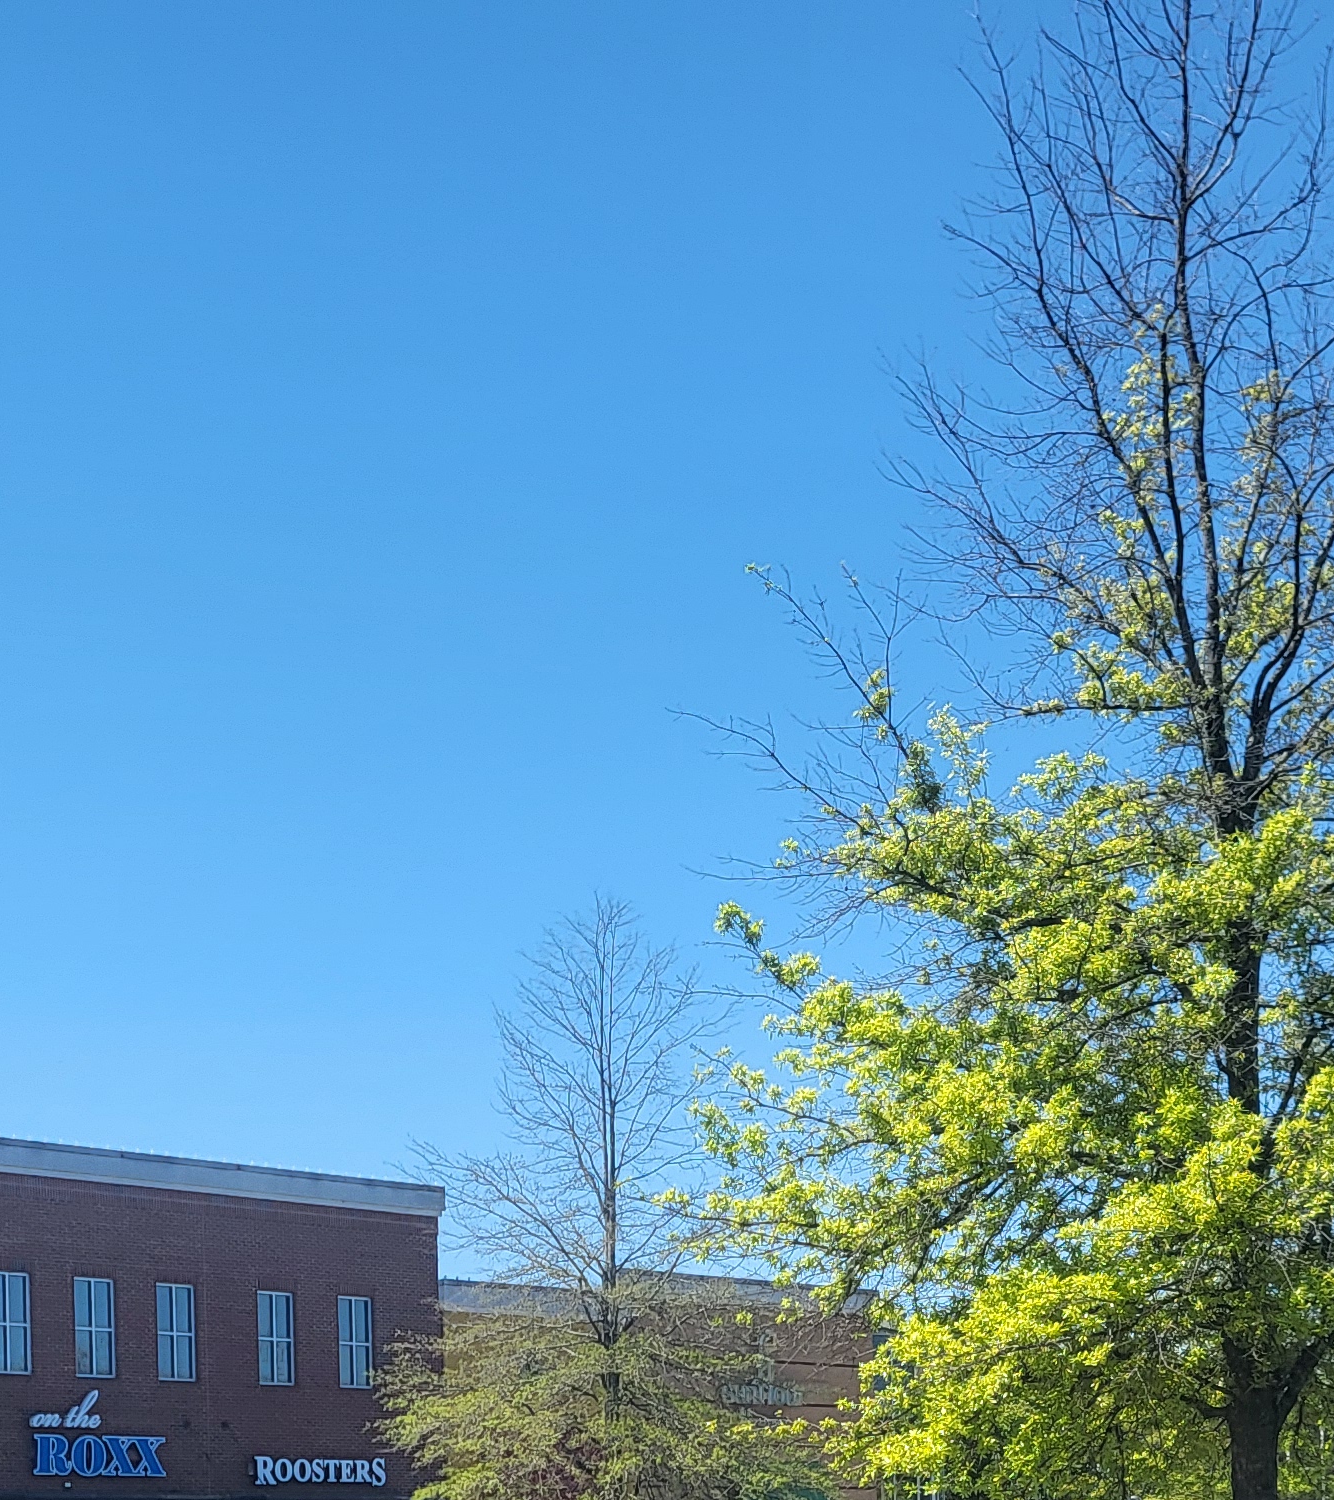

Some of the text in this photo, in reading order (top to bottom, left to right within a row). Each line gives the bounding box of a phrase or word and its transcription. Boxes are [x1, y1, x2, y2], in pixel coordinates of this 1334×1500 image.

[30, 1389, 101, 1429] on the
[33, 1433, 167, 1477] ROXX
[254, 1455, 386, 1487] ROOSTERS
